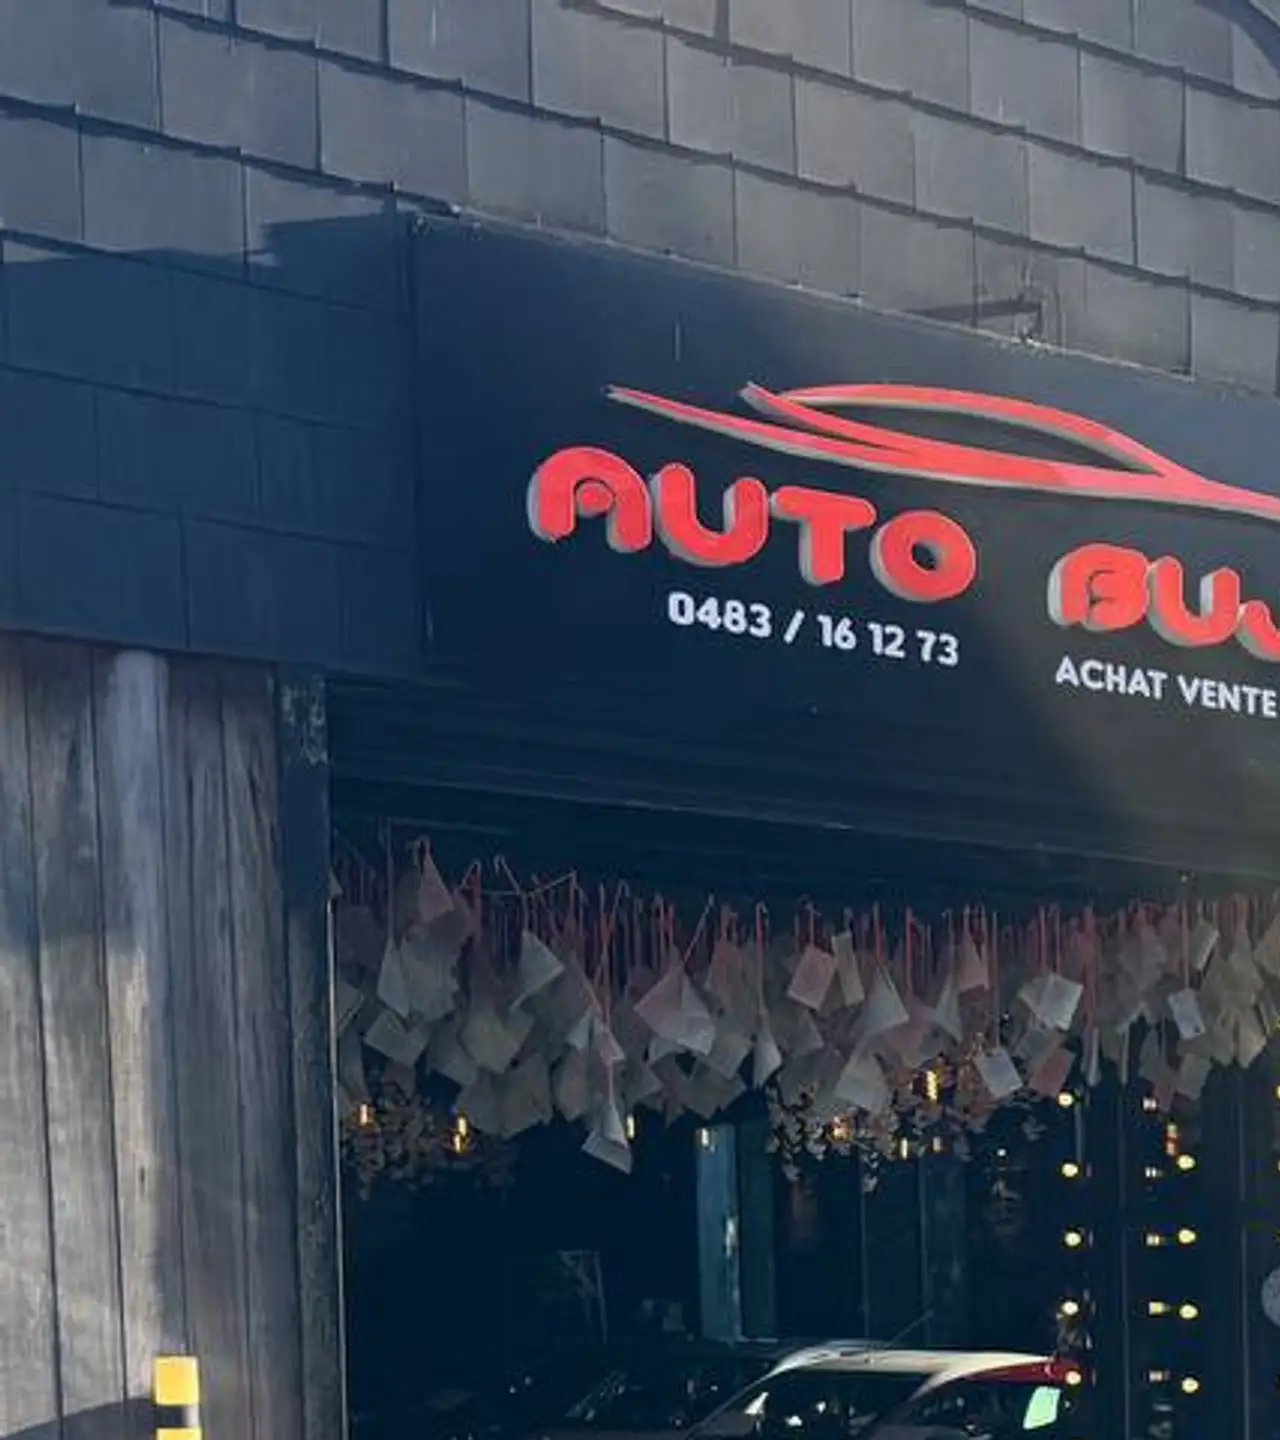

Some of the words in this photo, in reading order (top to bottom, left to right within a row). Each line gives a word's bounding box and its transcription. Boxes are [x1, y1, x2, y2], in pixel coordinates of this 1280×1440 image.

[527, 446, 977, 602] AUTO
[667, 591, 772, 638] 0483
[783, 610, 805, 643] /
[817, 614, 857, 650] 16
[867, 622, 906, 660] 12
[915, 630, 960, 666] 73
[1055, 655, 1168, 699] ACHAT
[1177, 674, 1278, 718] VENTE
